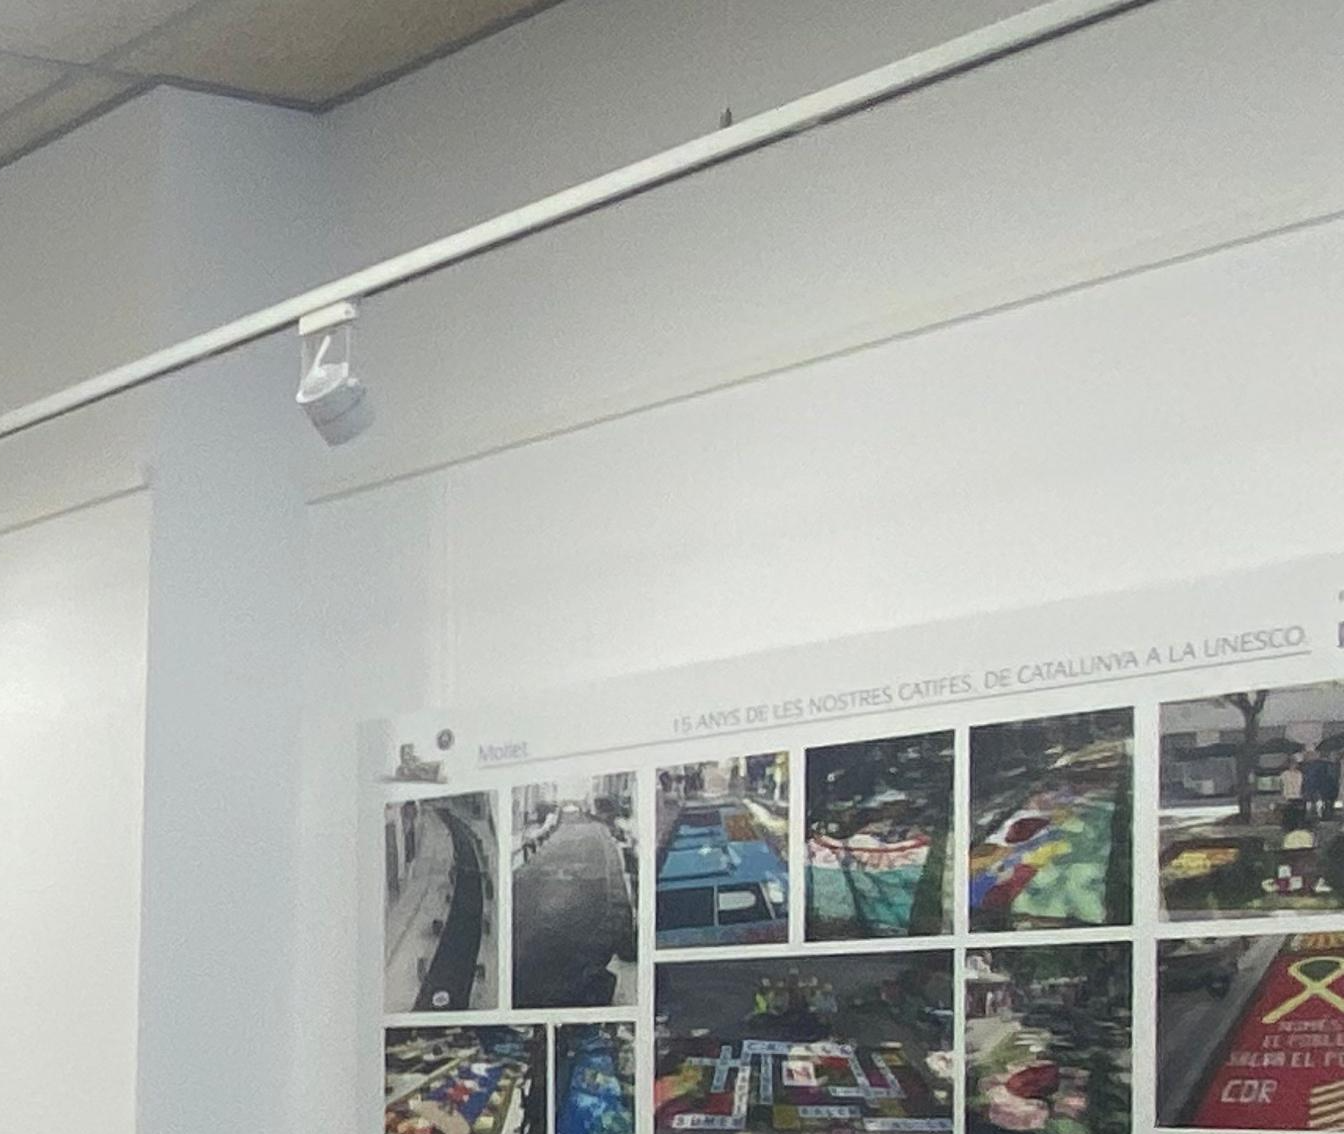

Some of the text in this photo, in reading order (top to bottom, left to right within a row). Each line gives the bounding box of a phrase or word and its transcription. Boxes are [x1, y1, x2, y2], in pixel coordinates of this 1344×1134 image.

[673, 714, 694, 734] 15
[696, 708, 742, 731] ANYS
[745, 703, 769, 725] DE
[772, 698, 804, 720] LES
[808, 686, 893, 718] NOSTRES
[984, 668, 1015, 690] DE
[1017, 650, 1139, 685] CATALUNYA
[1145, 647, 1162, 667] A
[1168, 640, 1197, 664] LA
[1221, 1079, 1279, 1103] CDR
